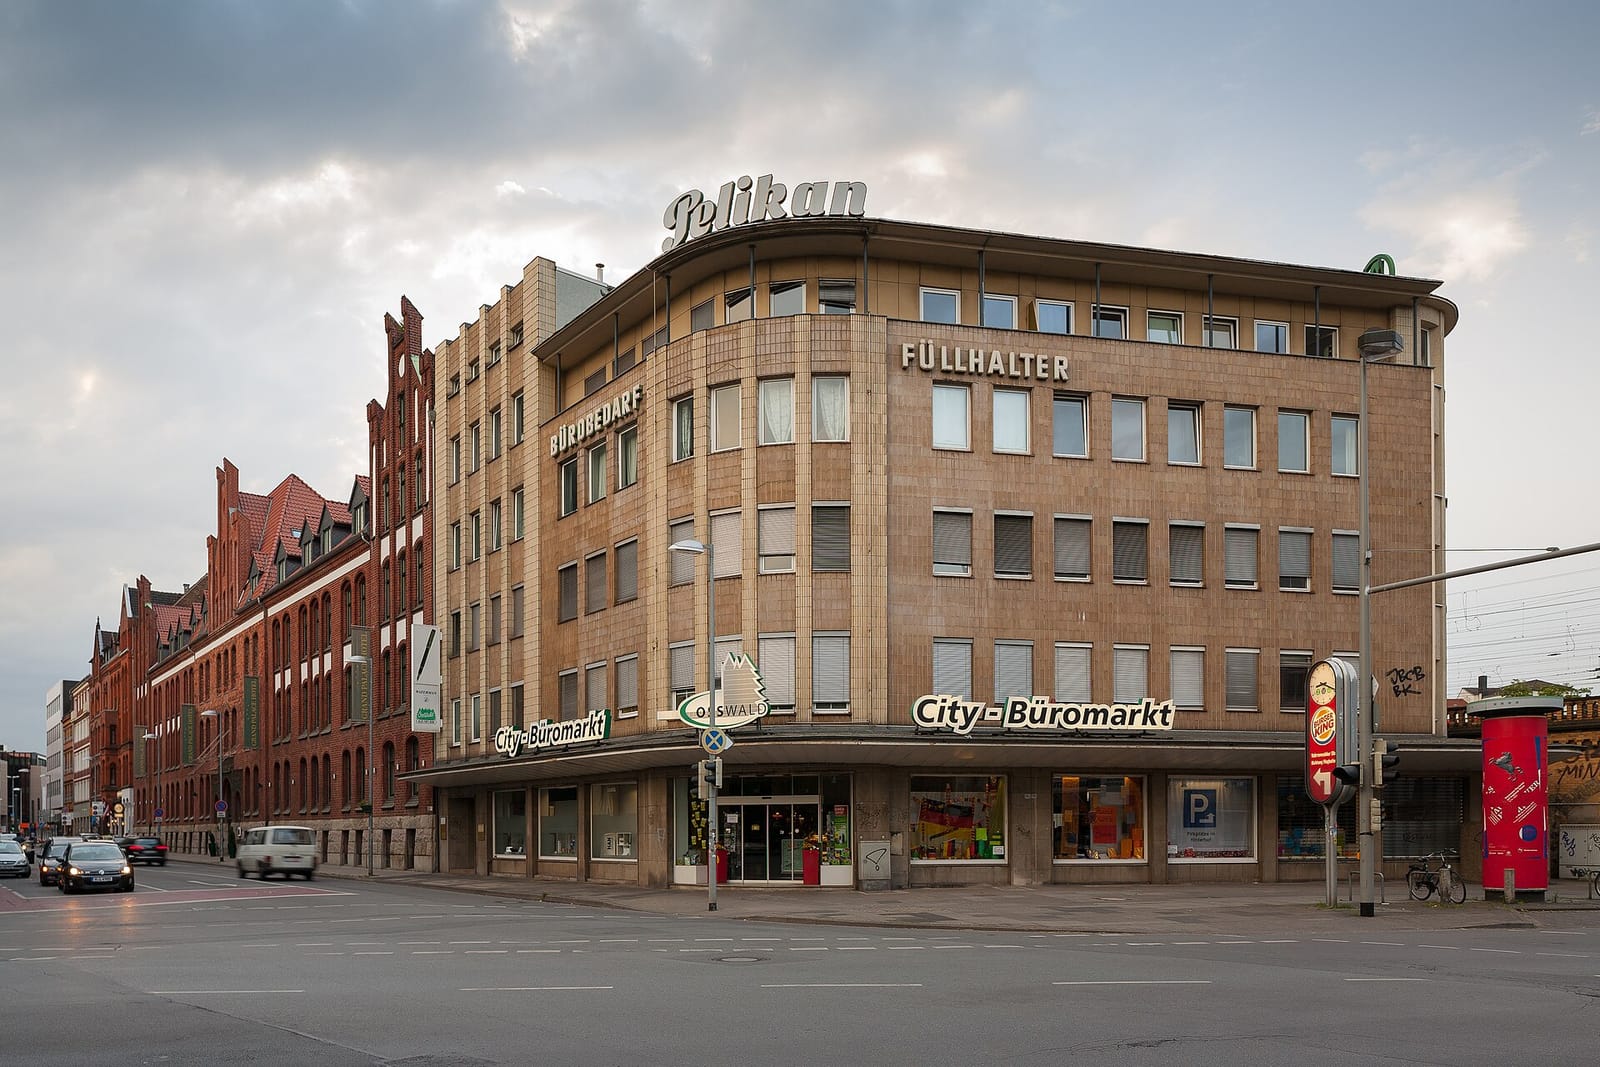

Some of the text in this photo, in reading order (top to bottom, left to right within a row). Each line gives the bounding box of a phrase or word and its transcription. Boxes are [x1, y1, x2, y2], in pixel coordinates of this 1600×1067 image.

[663, 174, 867, 254] Pelikan
[902, 339, 1069, 382] FÜLLHALTER
[550, 384, 643, 458] BÜROBEDARF
[496, 710, 606, 756] City-Büromarkt
[914, 696, 1174, 732] City-Büromarkt
[1314, 712, 1334, 728] BURGER
[1314, 719, 1335, 737] KING
